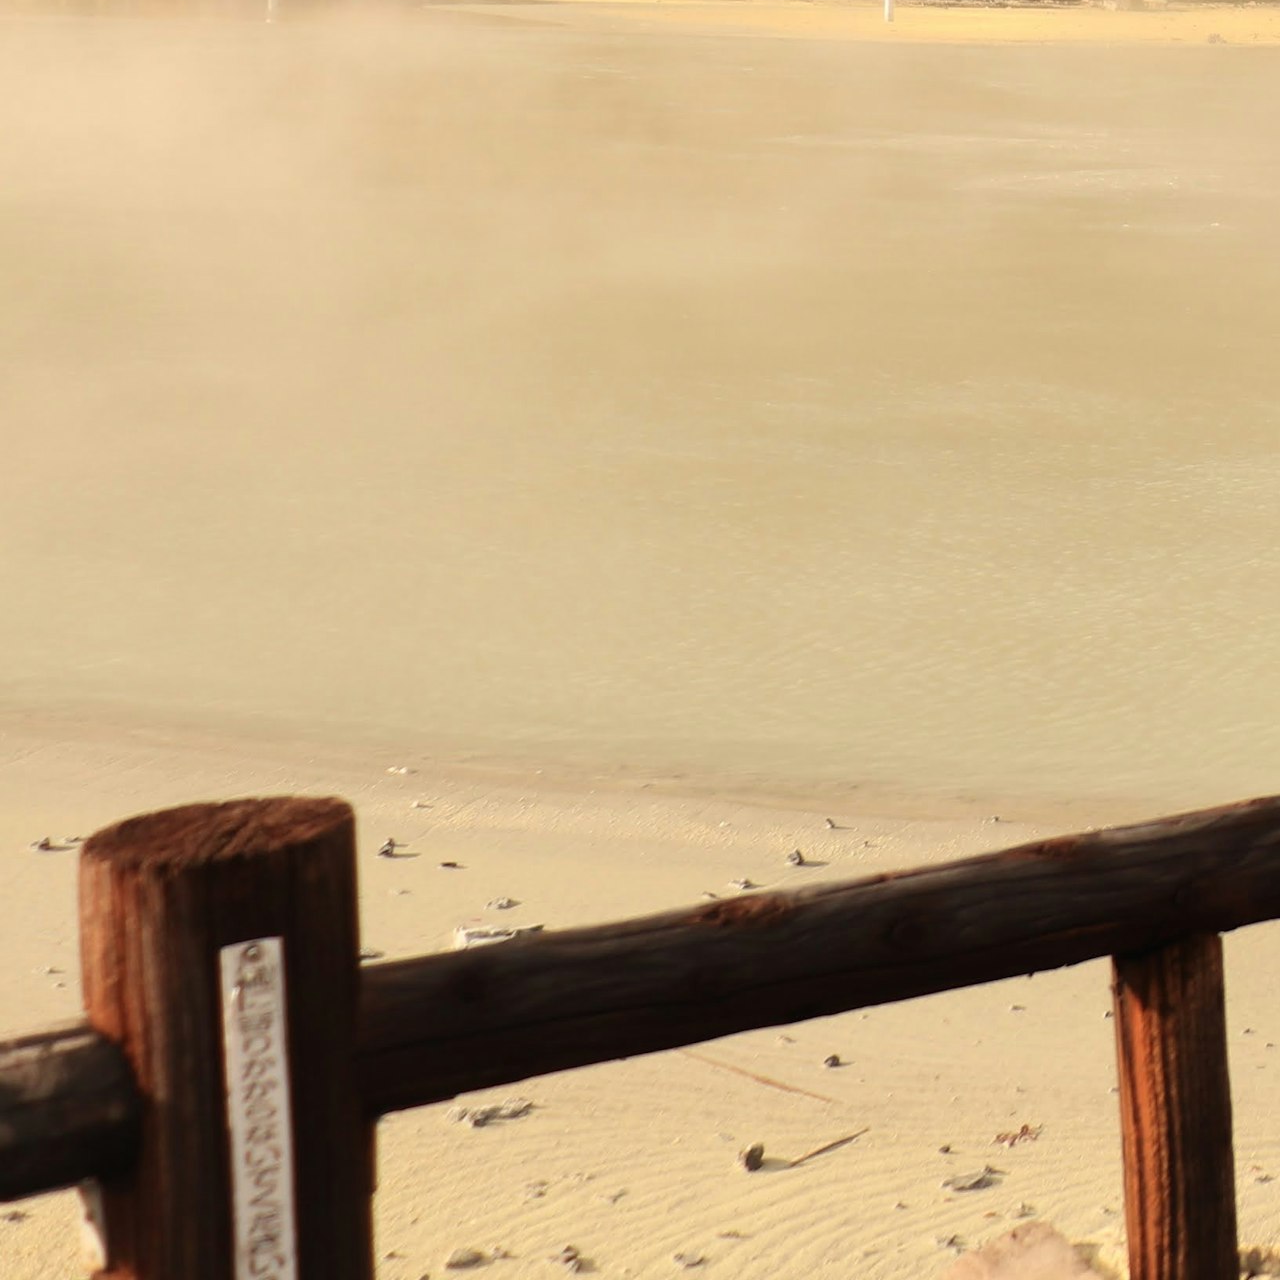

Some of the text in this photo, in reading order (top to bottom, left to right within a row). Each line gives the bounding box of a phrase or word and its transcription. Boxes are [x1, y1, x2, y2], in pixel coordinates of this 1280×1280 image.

[237, 965, 286, 1277] にりかからないでください
